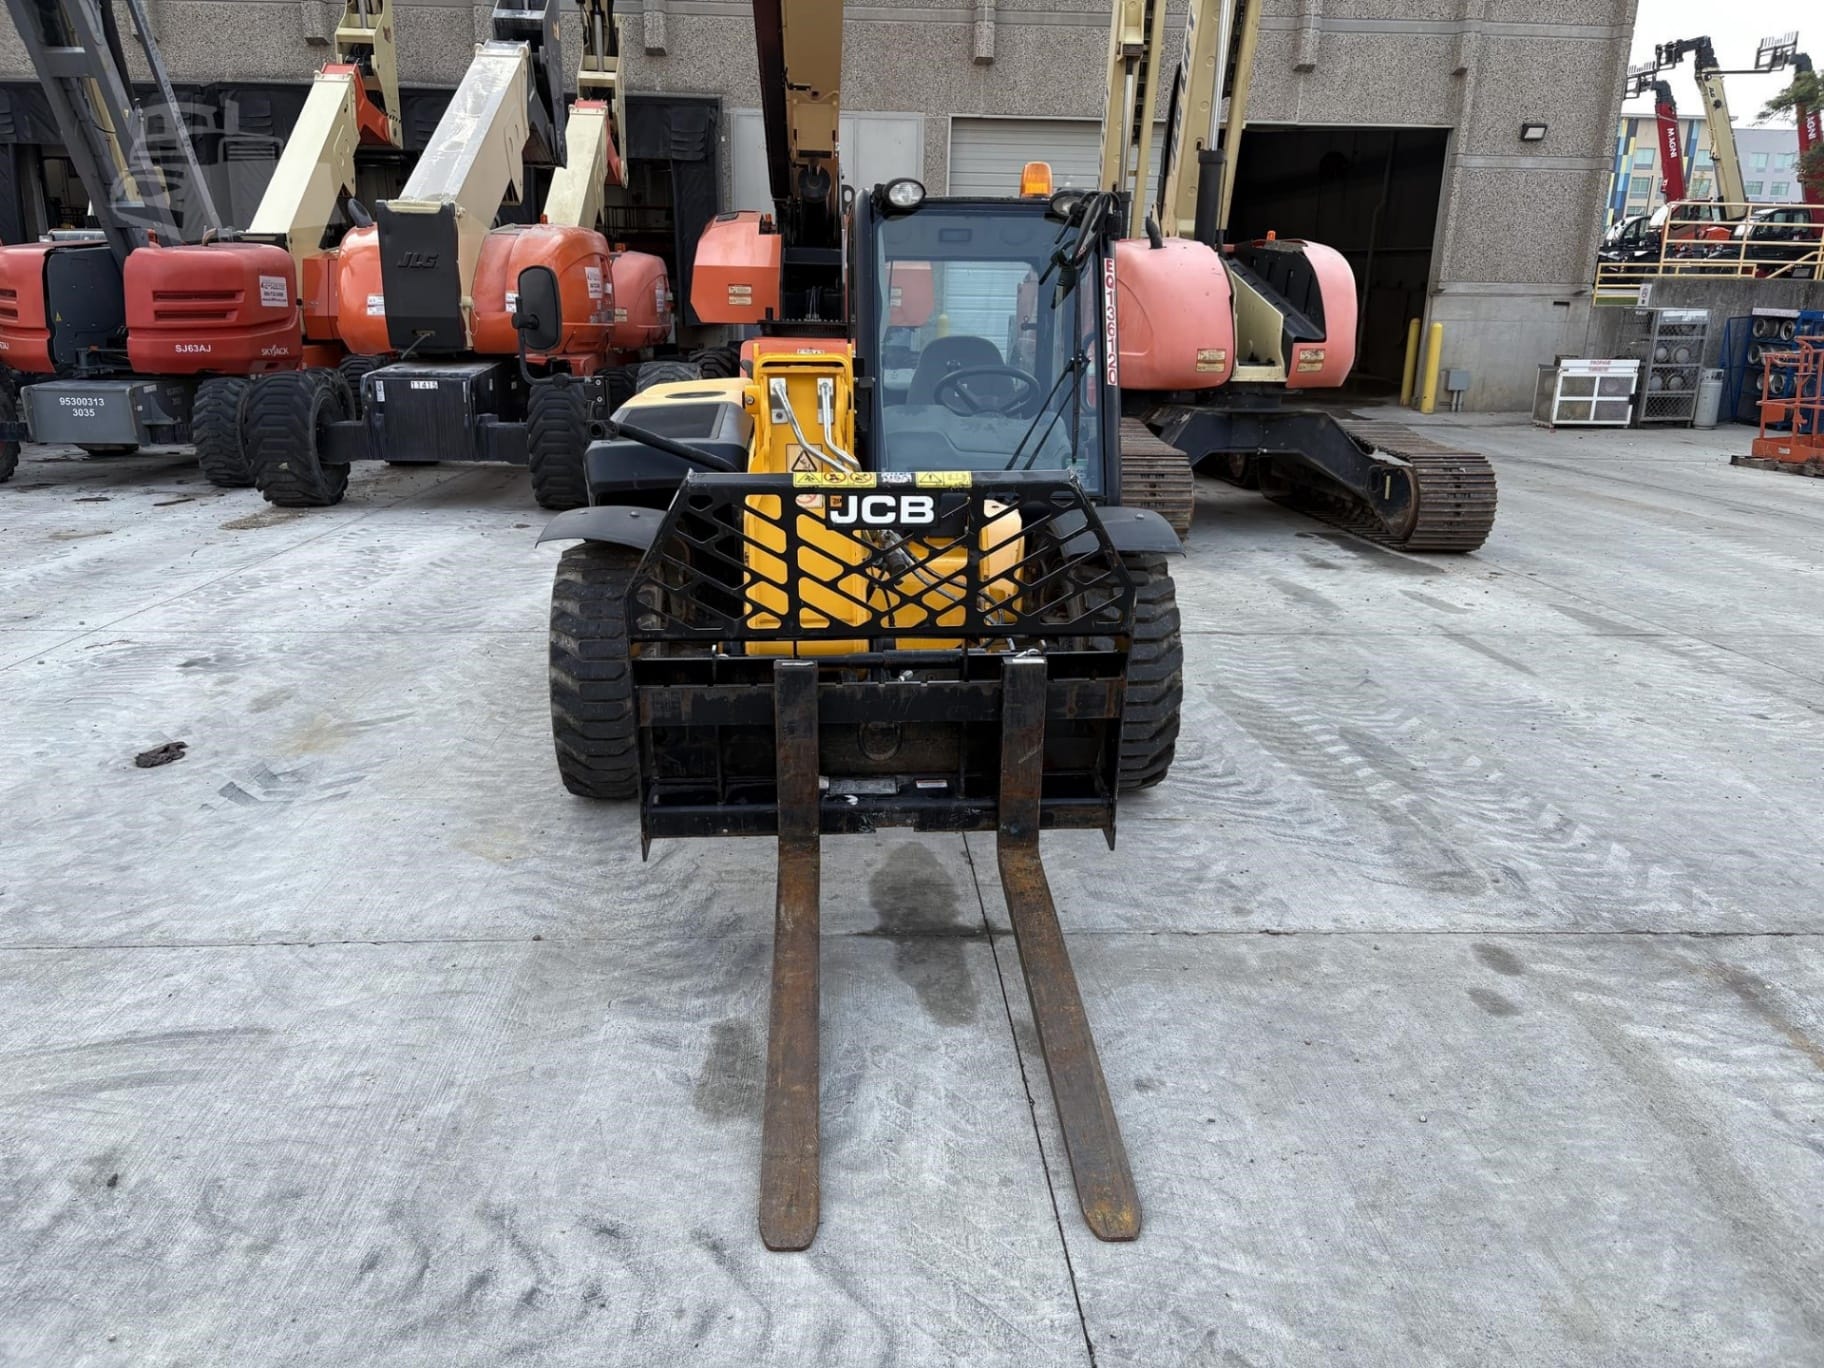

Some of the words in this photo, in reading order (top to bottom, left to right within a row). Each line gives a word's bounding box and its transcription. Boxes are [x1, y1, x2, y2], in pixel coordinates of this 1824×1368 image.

[1667, 127, 1678, 159] MAGNI
[397, 251, 438, 269] JLG
[1105, 259, 1118, 385] EQ136120
[175, 343, 212, 353] SJ63AJ
[59, 396, 105, 407] 95300313
[72, 407, 96, 417] 3035
[829, 495, 935, 524] JCB
